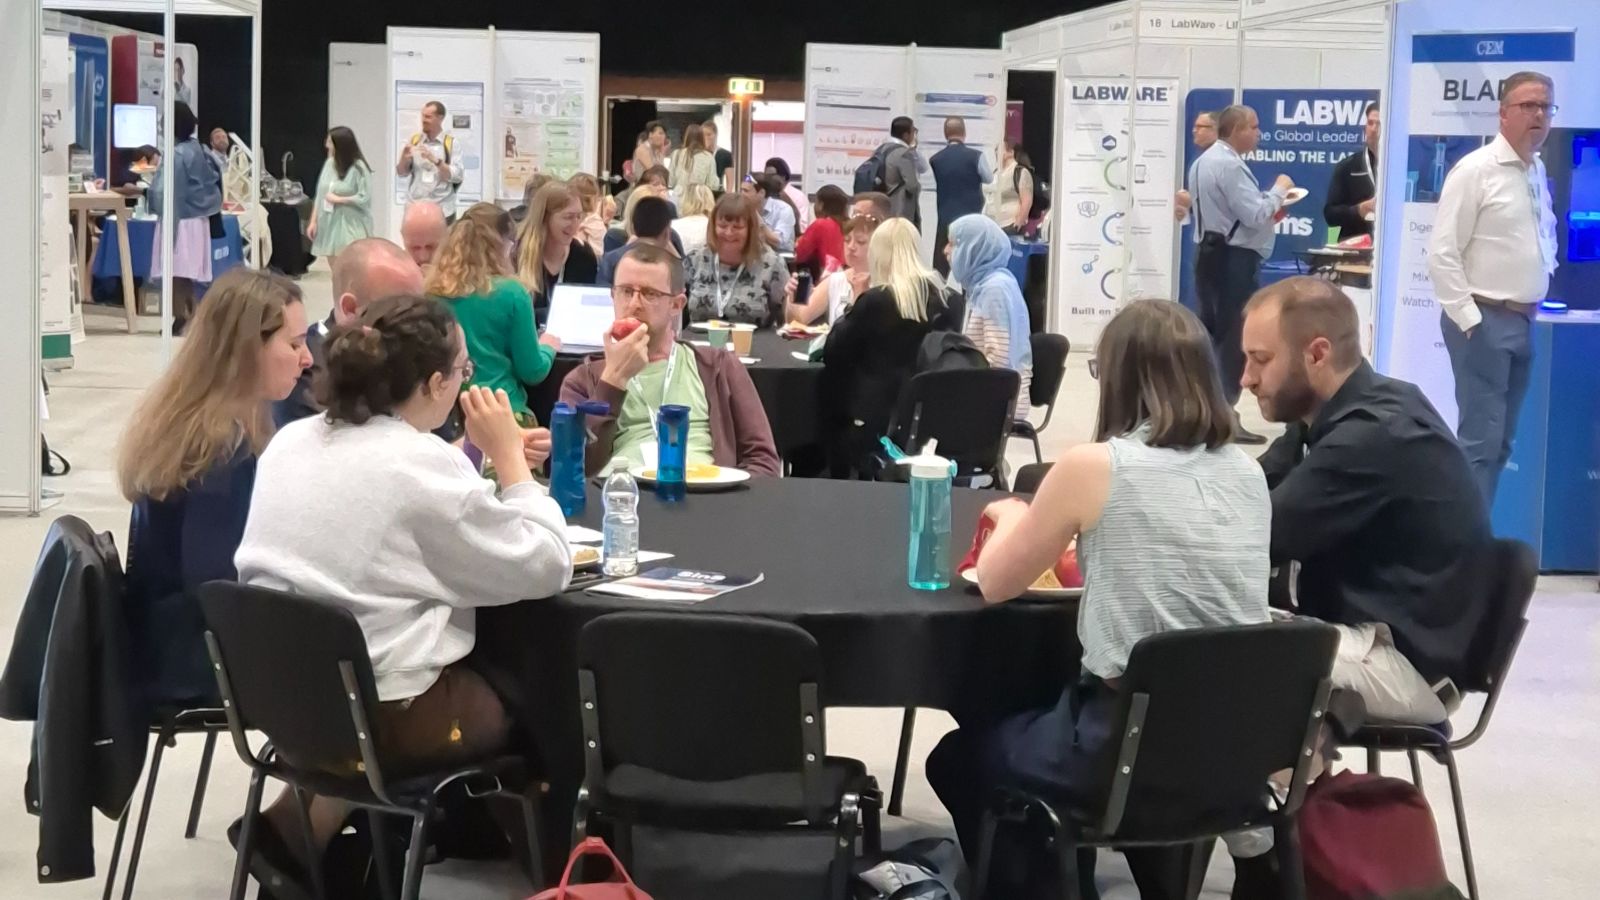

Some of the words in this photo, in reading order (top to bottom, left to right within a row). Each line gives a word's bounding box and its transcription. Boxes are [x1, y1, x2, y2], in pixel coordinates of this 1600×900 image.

[1149, 18, 1162, 28] 18
[1171, 19, 1216, 29] LabWare
[1226, 20, 1239, 30] LI
[1476, 40, 1504, 55] CEM
[1274, 129, 1314, 142] Global
[1316, 130, 1359, 143] Leader
[1299, 151, 1326, 163] THE
[1329, 152, 1355, 164] LA
[1402, 296, 1434, 308] Watch
